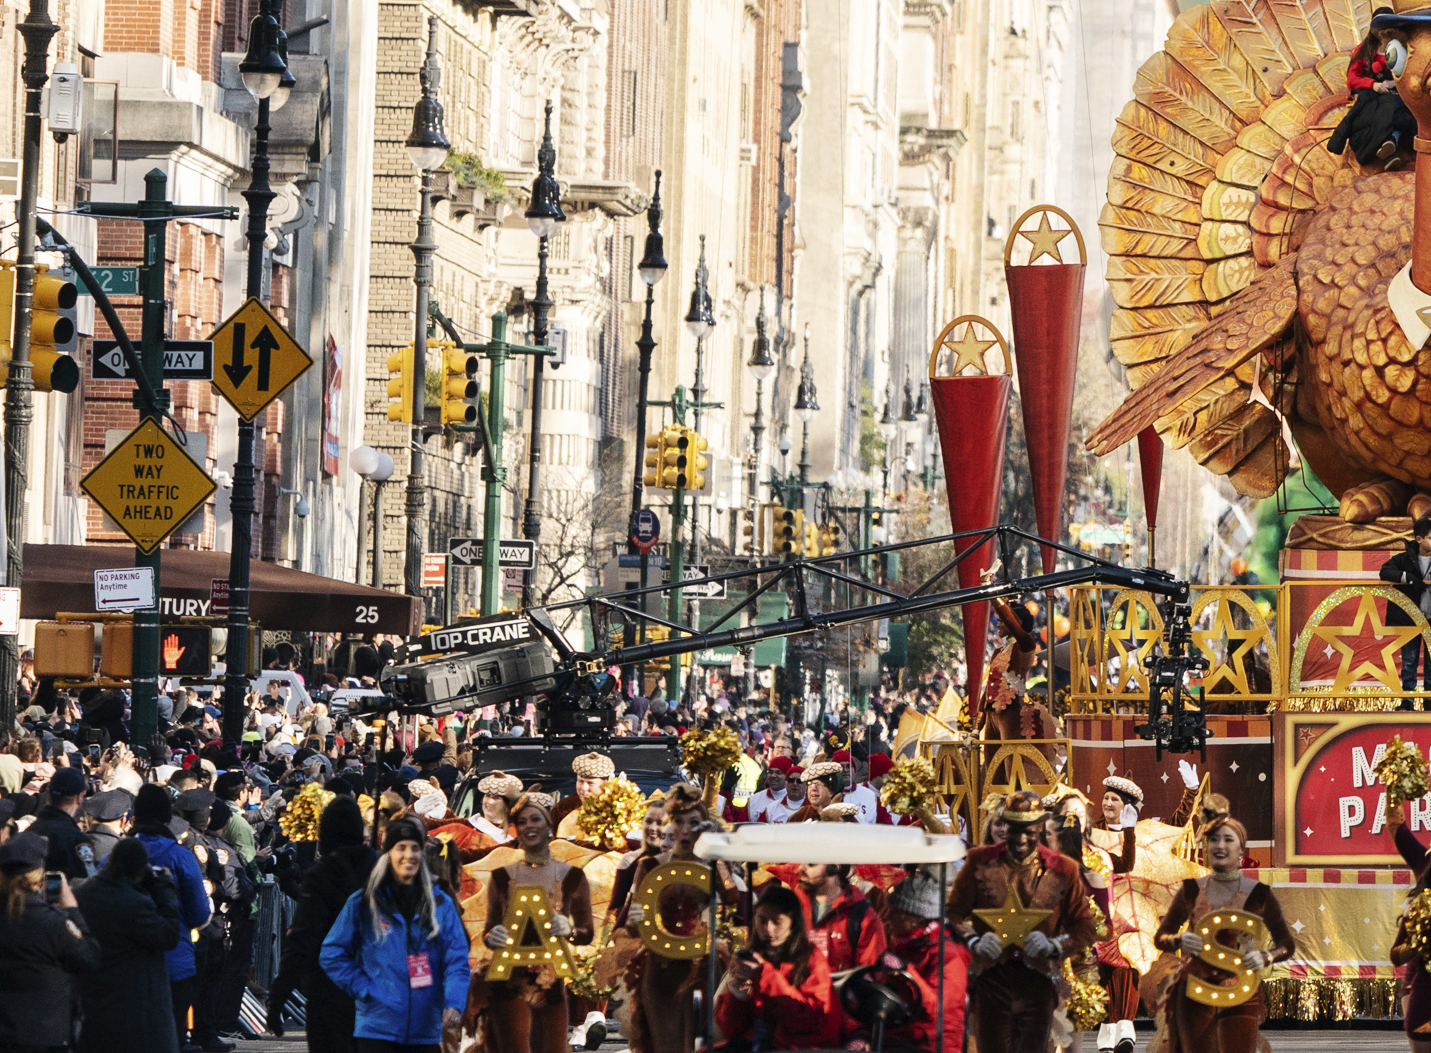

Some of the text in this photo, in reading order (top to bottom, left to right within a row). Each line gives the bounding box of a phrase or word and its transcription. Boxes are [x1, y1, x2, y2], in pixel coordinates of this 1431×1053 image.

[92, 269, 135, 292] 2 ST
[134, 444, 165, 459] TWO
[134, 464, 163, 479] WAY
[118, 484, 180, 500] TRAFFIC
[123, 505, 174, 520] AHEAD
[500, 549, 526, 559] WAY
[110, 572, 140, 581] PARKING
[100, 583, 128, 592] Anytime
[213, 591, 229, 599] Anytim
[355, 606, 379, 624] 25
[485, 885, 578, 981] A
[1186, 909, 1264, 1007] S
